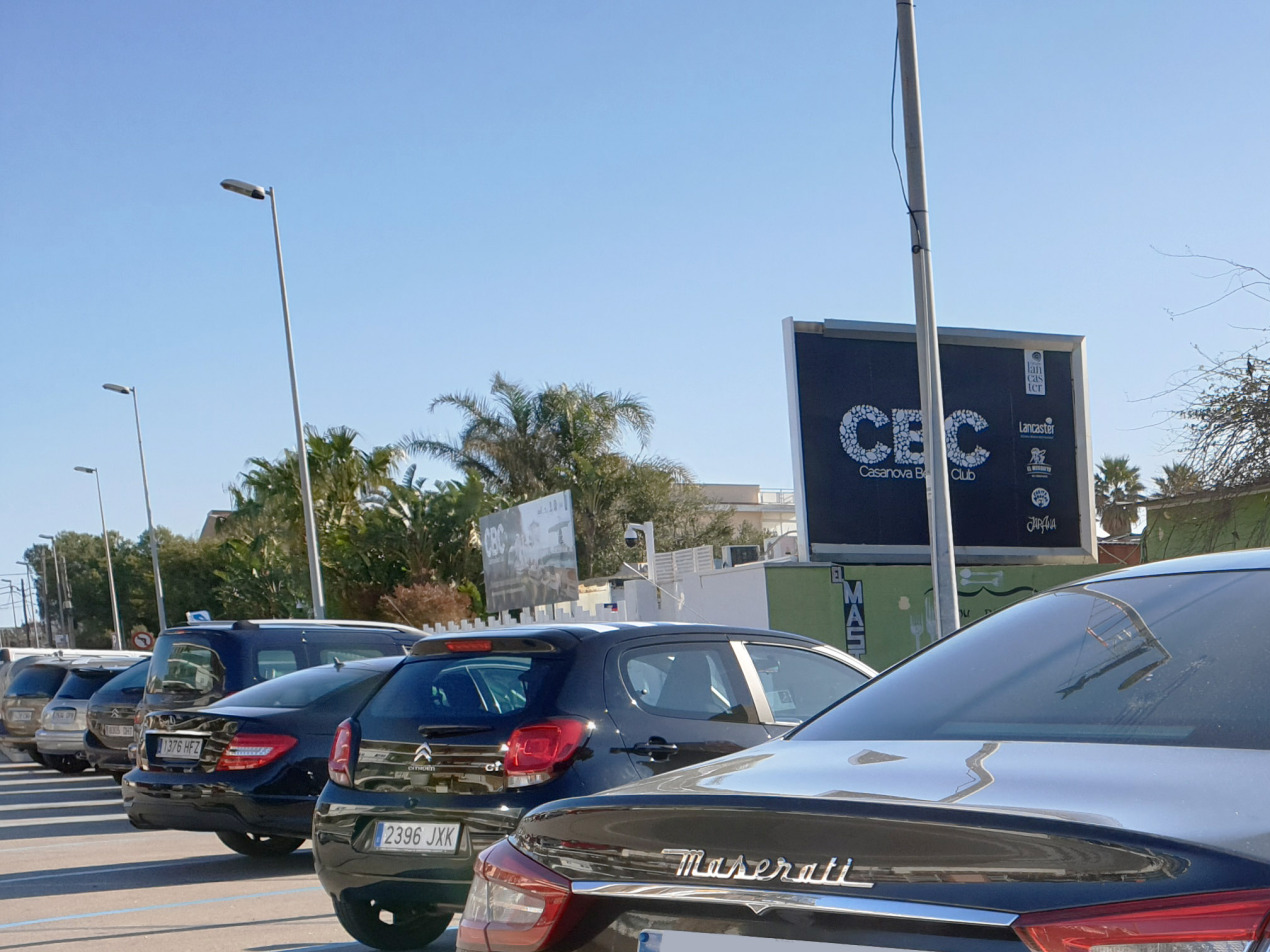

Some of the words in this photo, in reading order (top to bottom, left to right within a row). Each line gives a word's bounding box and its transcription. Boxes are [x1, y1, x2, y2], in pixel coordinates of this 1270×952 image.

[1019, 421, 1055, 435] Lancaster
[859, 465, 914, 479] Casanova
[950, 468, 976, 481] Club
[164, 740, 183, 752] 1376
[184, 740, 200, 754] HFZ
[384, 825, 422, 846] 2396
[426, 826, 456, 846] JXK
[661, 848, 874, 889] Maserati
